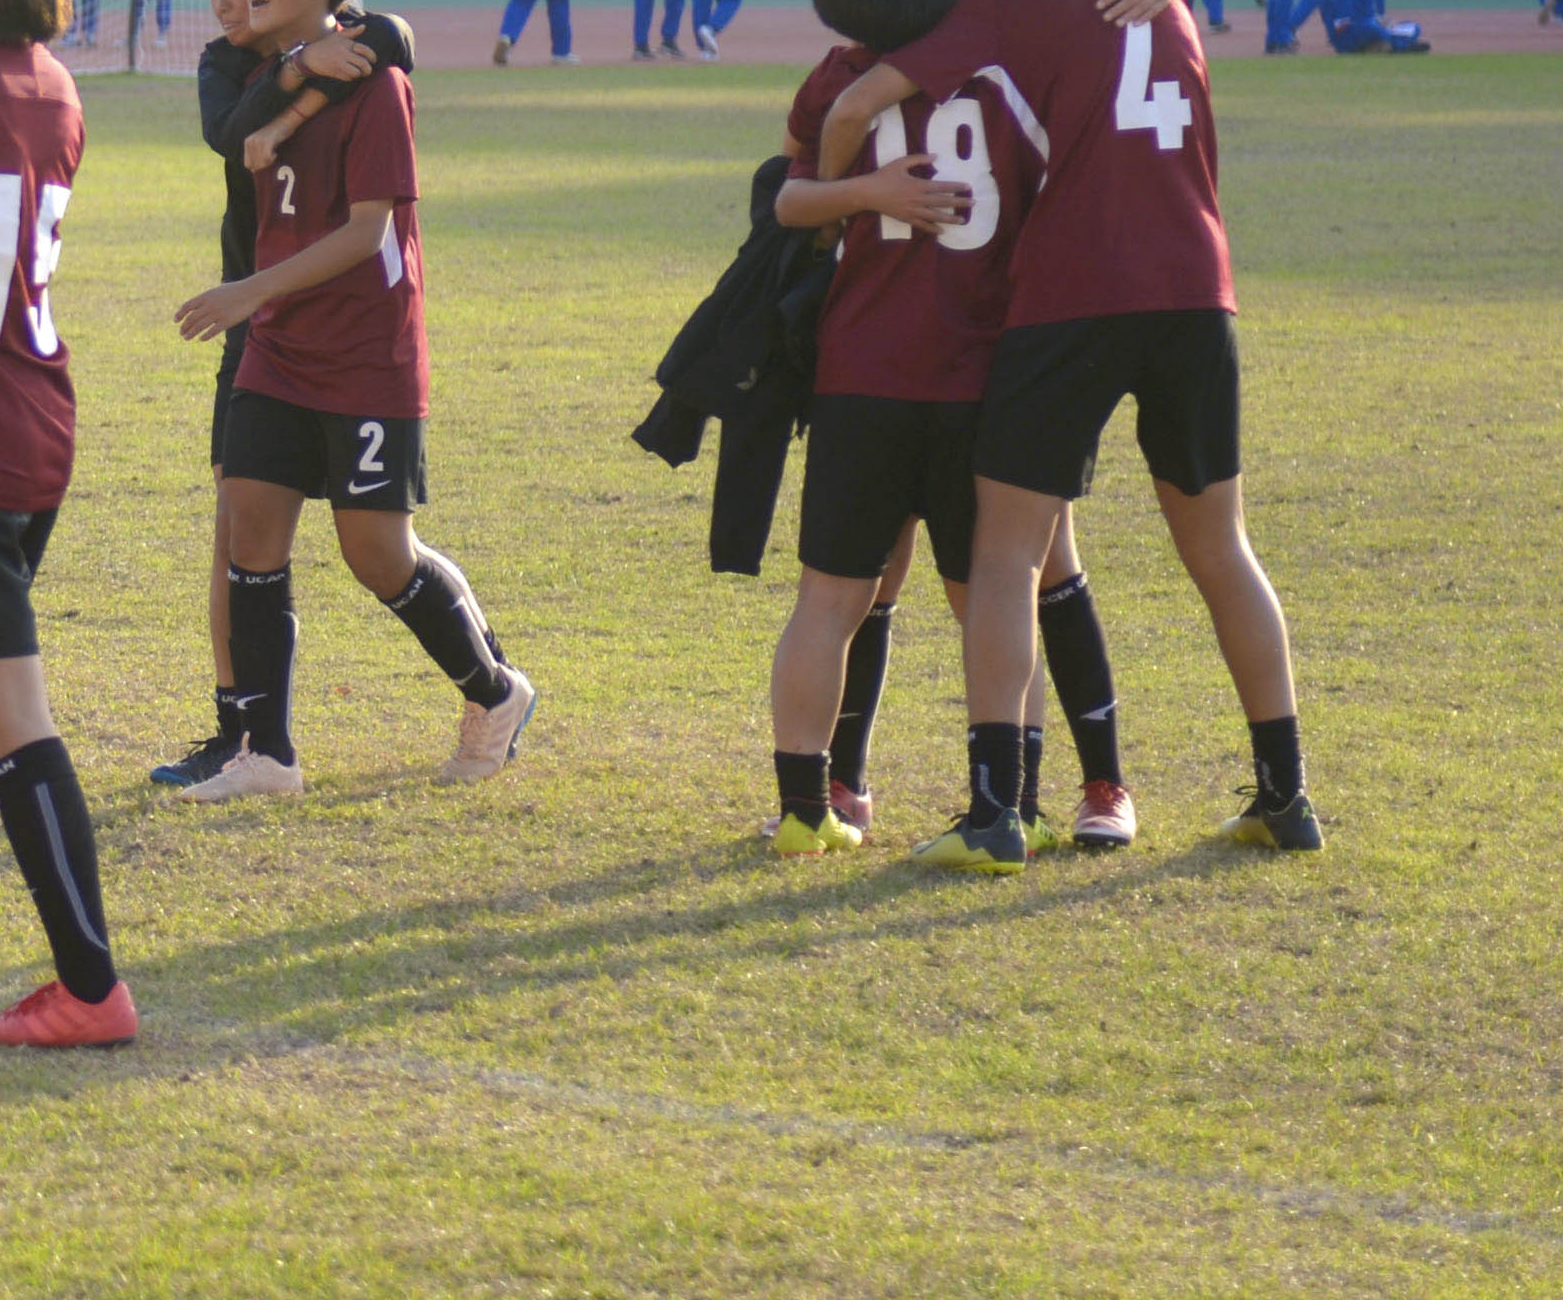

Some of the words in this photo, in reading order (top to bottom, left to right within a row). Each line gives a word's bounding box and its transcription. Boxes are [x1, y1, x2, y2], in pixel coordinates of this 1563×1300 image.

[1116, 25, 1192, 150] 4
[277, 165, 296, 216] 2
[359, 421, 386, 473] 2
